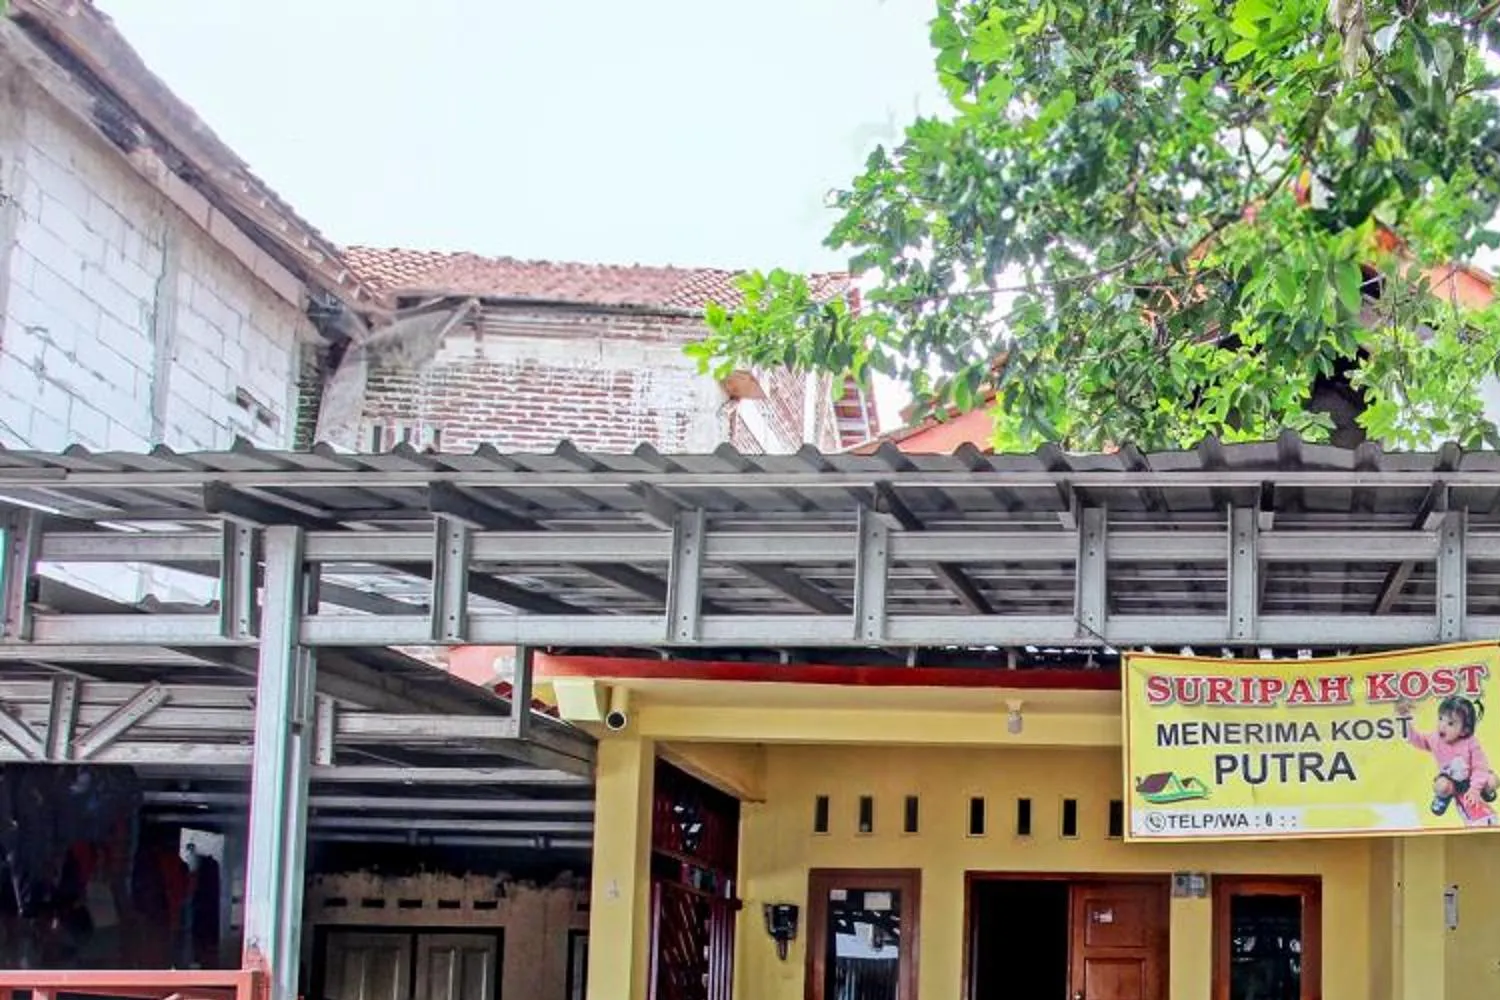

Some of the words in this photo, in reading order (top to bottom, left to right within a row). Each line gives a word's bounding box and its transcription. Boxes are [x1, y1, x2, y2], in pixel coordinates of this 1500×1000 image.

[1147, 674, 1350, 704] SURIPAH
[1366, 665, 1486, 701] KOST
[1156, 722, 1320, 747] MENERIMA
[1330, 717, 1413, 742] KOST
[1214, 752, 1357, 785] PUTRA
[1167, 813, 1249, 829] TELP/WA
